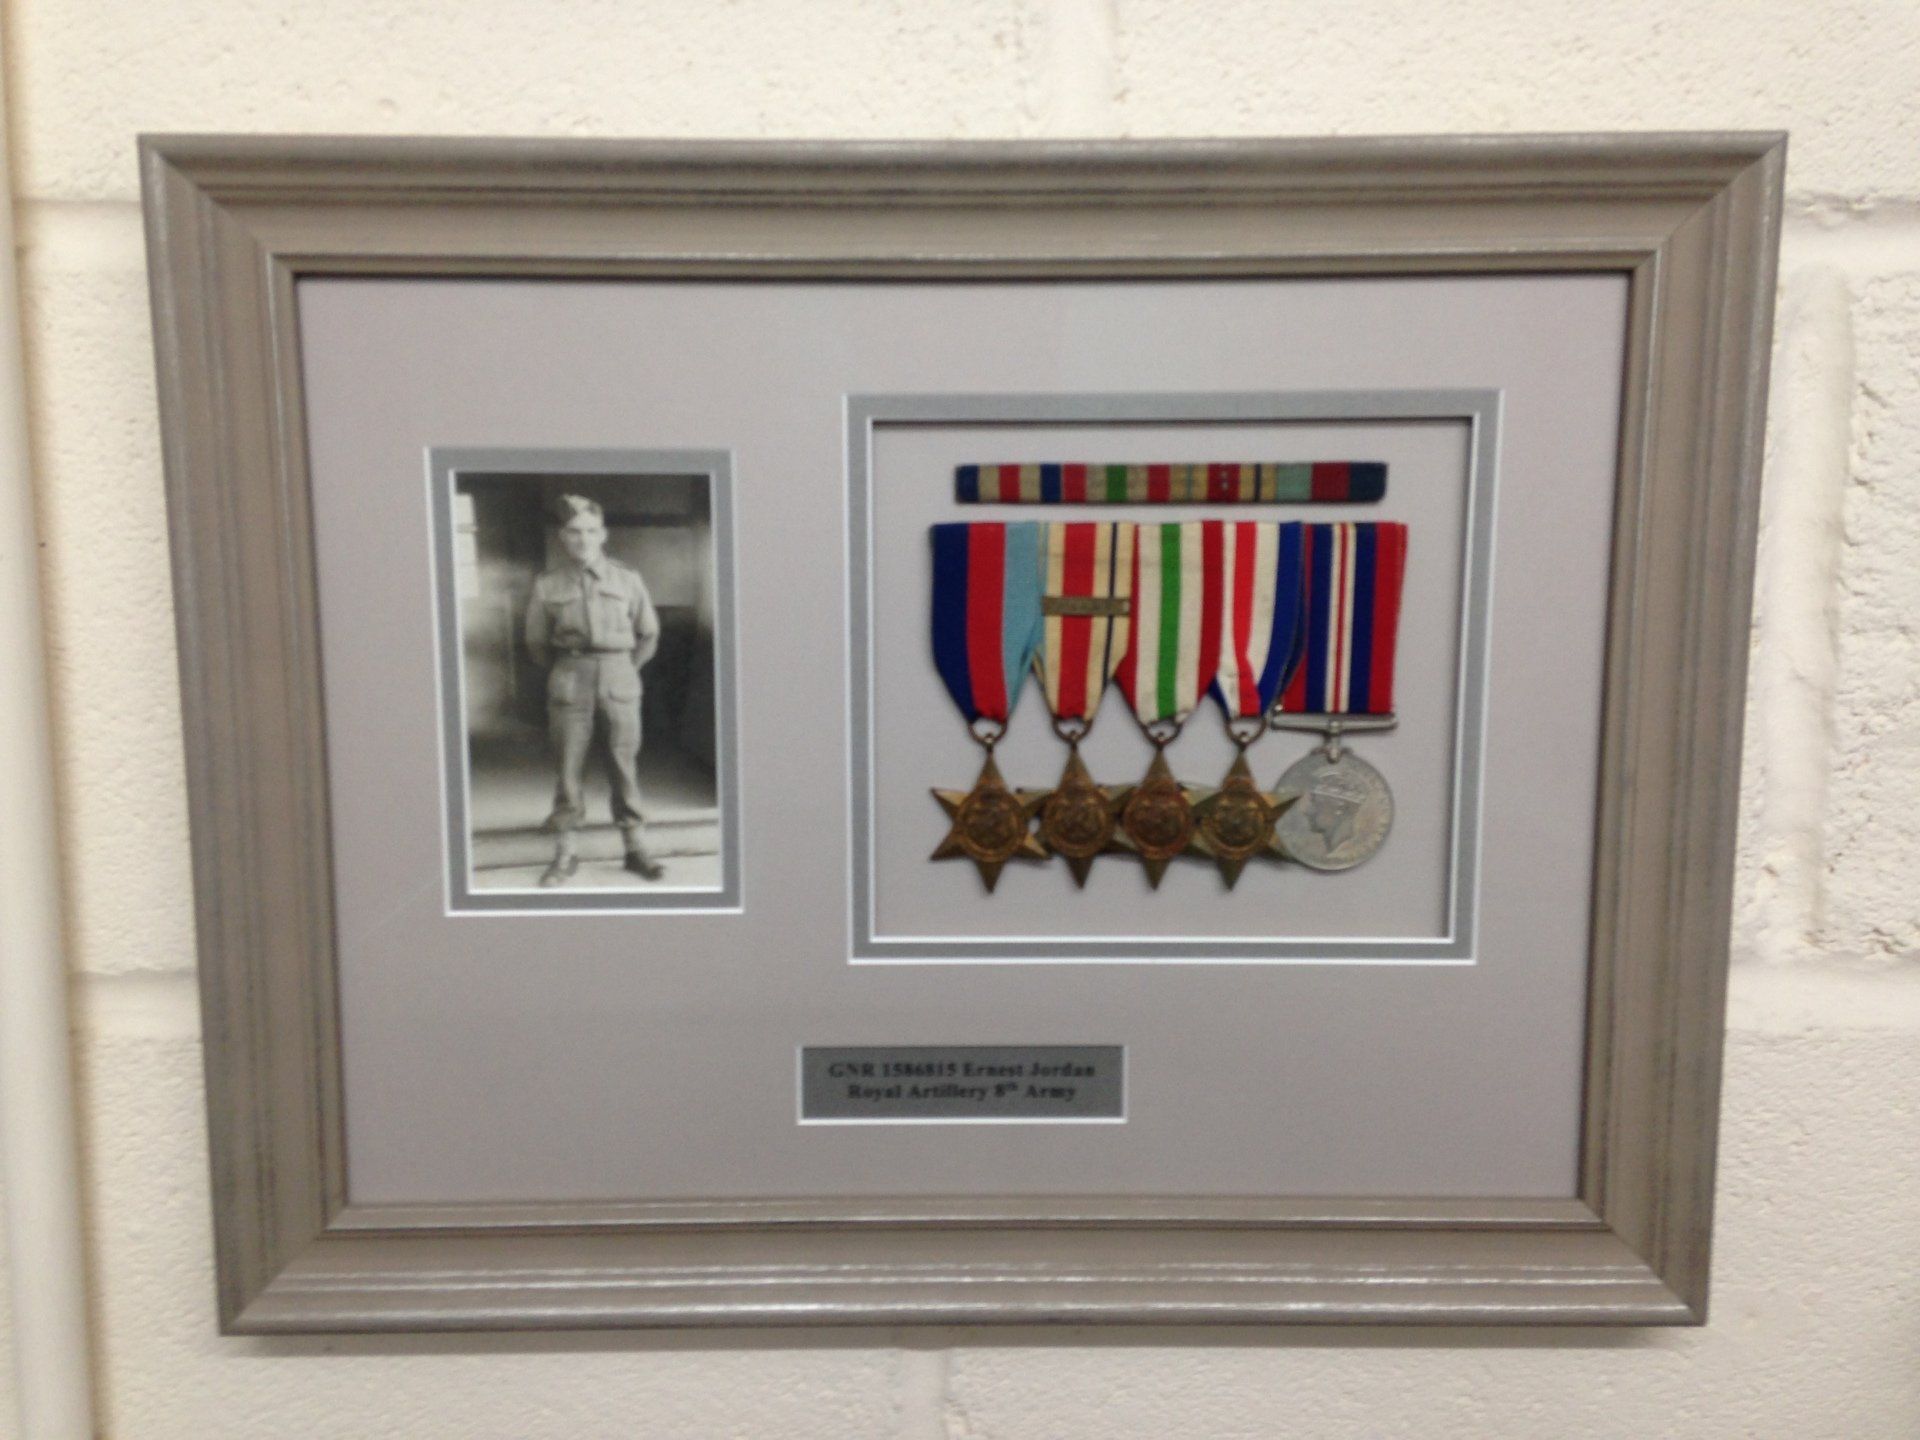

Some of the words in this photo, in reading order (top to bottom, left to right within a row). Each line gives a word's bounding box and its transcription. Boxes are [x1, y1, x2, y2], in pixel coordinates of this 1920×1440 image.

[828, 1062, 876, 1078] GNR
[962, 1061, 1023, 1077] Ernest
[1029, 1061, 1096, 1077] Jordan
[848, 1084, 902, 1102] Royal
[907, 1083, 987, 1102] Artillery
[1024, 1084, 1077, 1102] Army
